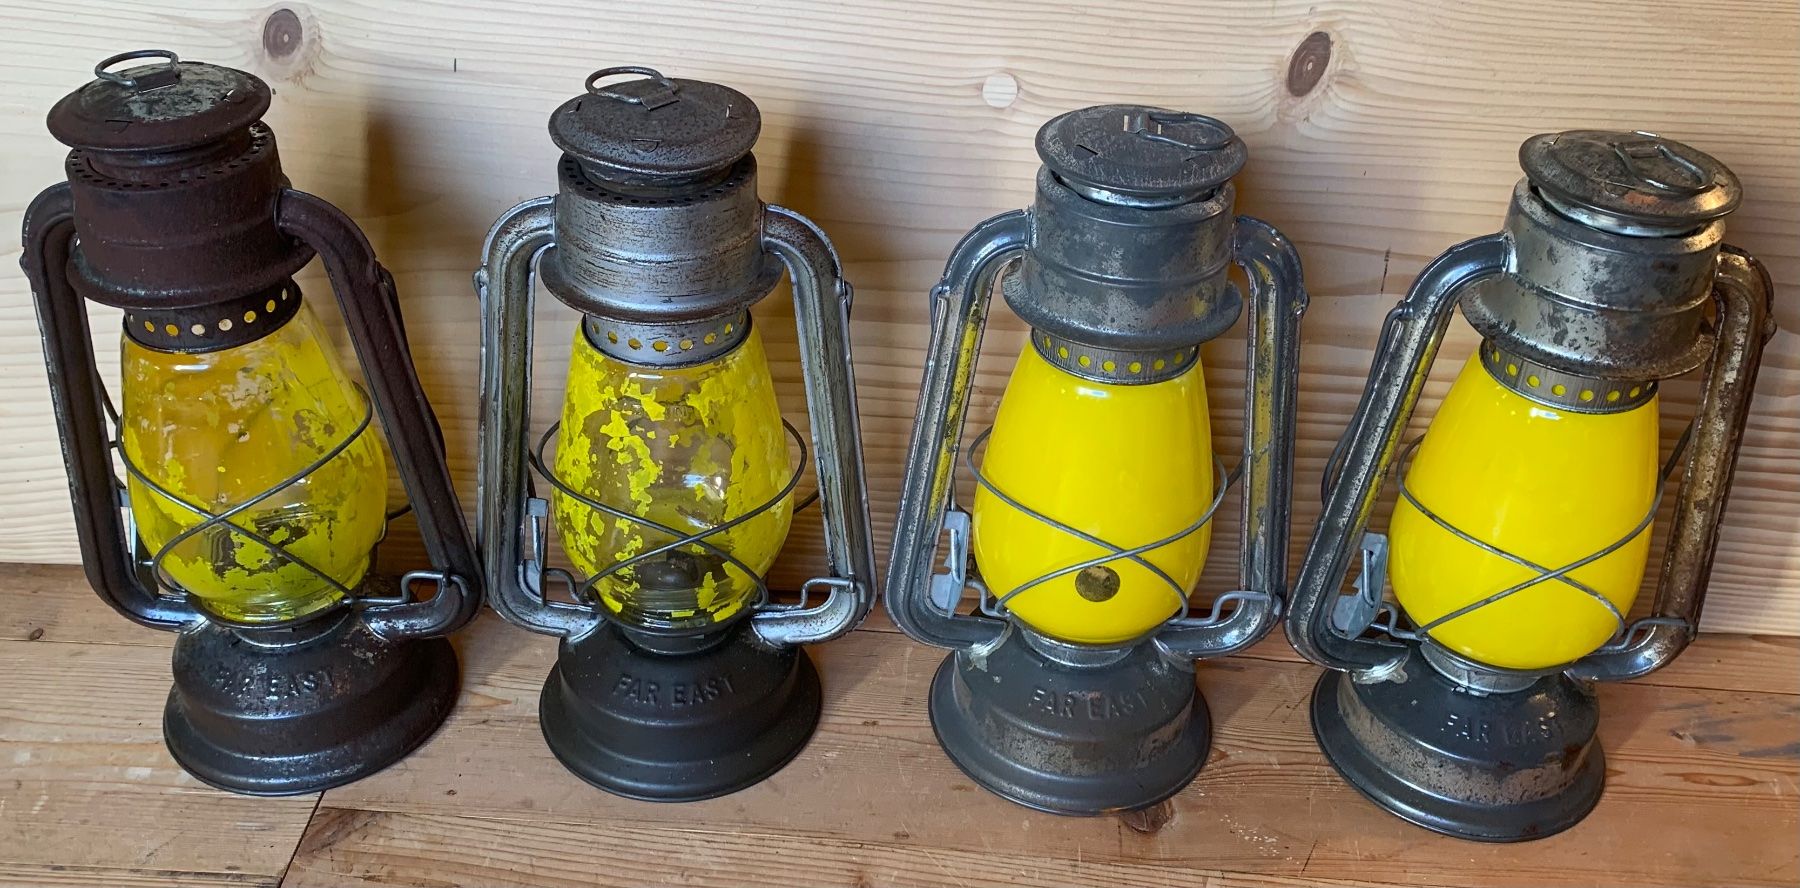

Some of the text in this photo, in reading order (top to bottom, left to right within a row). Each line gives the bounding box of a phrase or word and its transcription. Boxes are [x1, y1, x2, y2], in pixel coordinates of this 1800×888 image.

[265, 669, 335, 701] EAST
[612, 674, 734, 706] FAR EAST
[1027, 687, 1148, 720] FAR EAST
[1440, 714, 1489, 743] FAR
